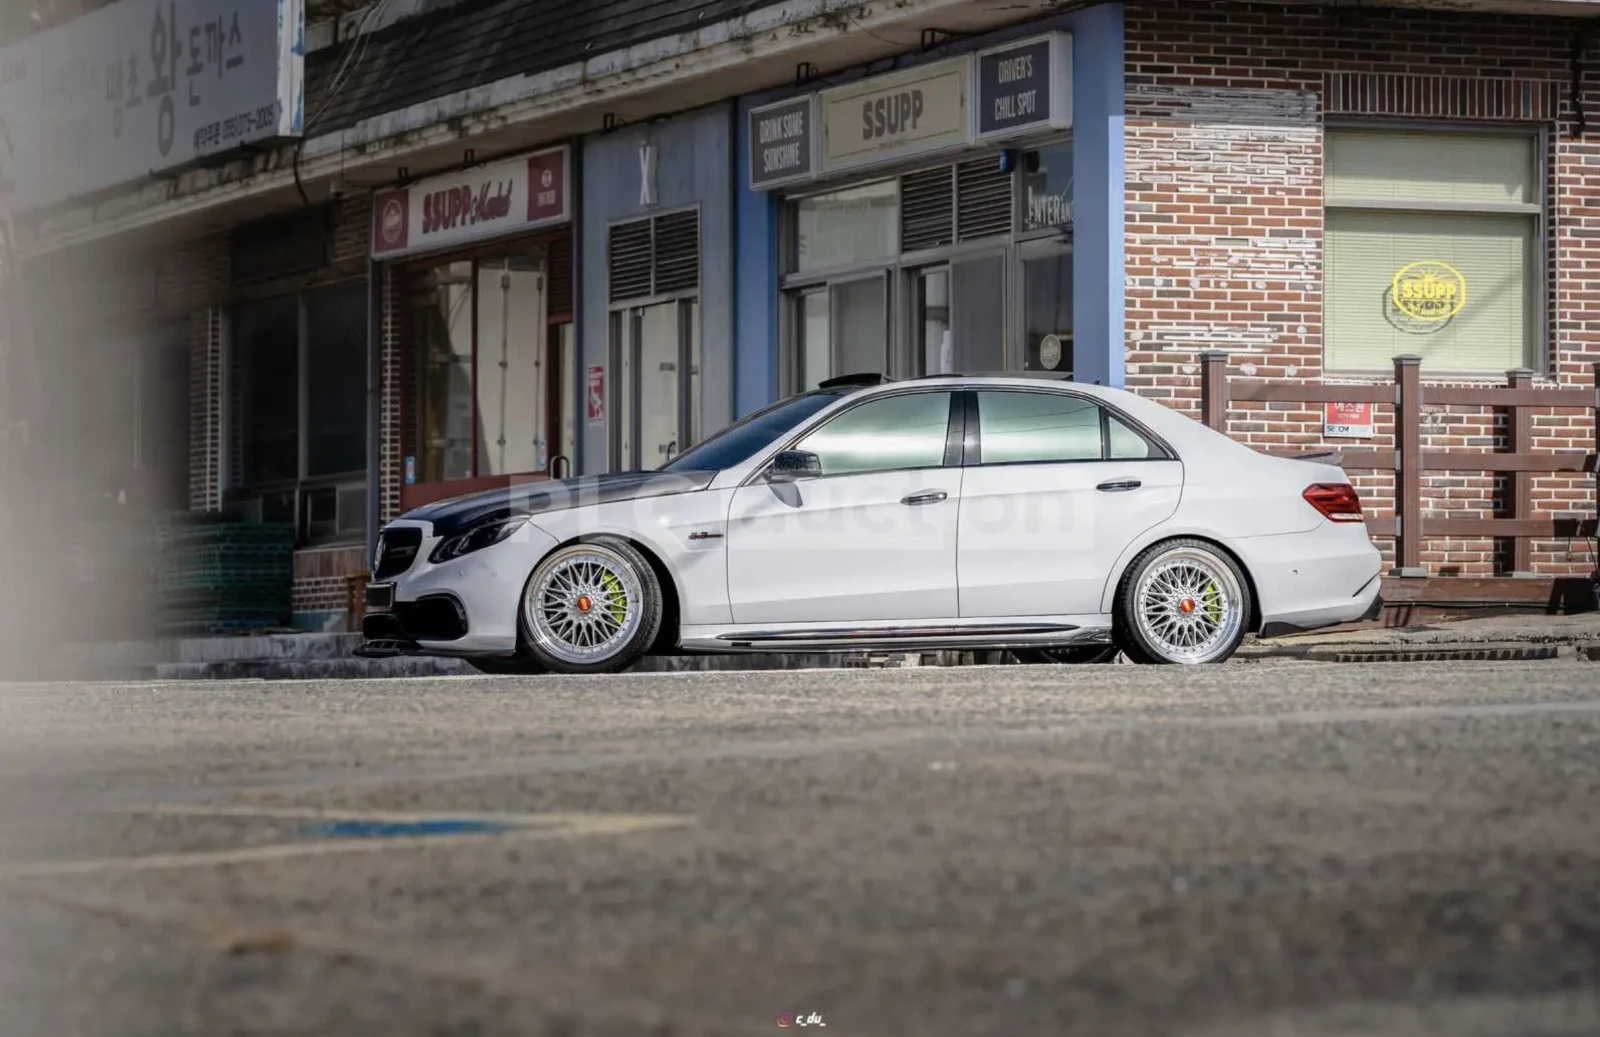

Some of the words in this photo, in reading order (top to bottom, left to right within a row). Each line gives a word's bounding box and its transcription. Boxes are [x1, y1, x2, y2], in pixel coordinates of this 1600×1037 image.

[998, 54, 1033, 84] DRIVER'S
[862, 89, 924, 141] SSUPP
[995, 94, 1016, 121] CHILL
[1017, 90, 1037, 116] SPOT
[760, 116, 783, 144] DRINK
[783, 111, 803, 138] SOME
[764, 142, 800, 173] SUNSHINE
[421, 183, 471, 234] SSUPP
[1028, 192, 1074, 225] ENTERAN
[1402, 280, 1456, 299] SSUPP
